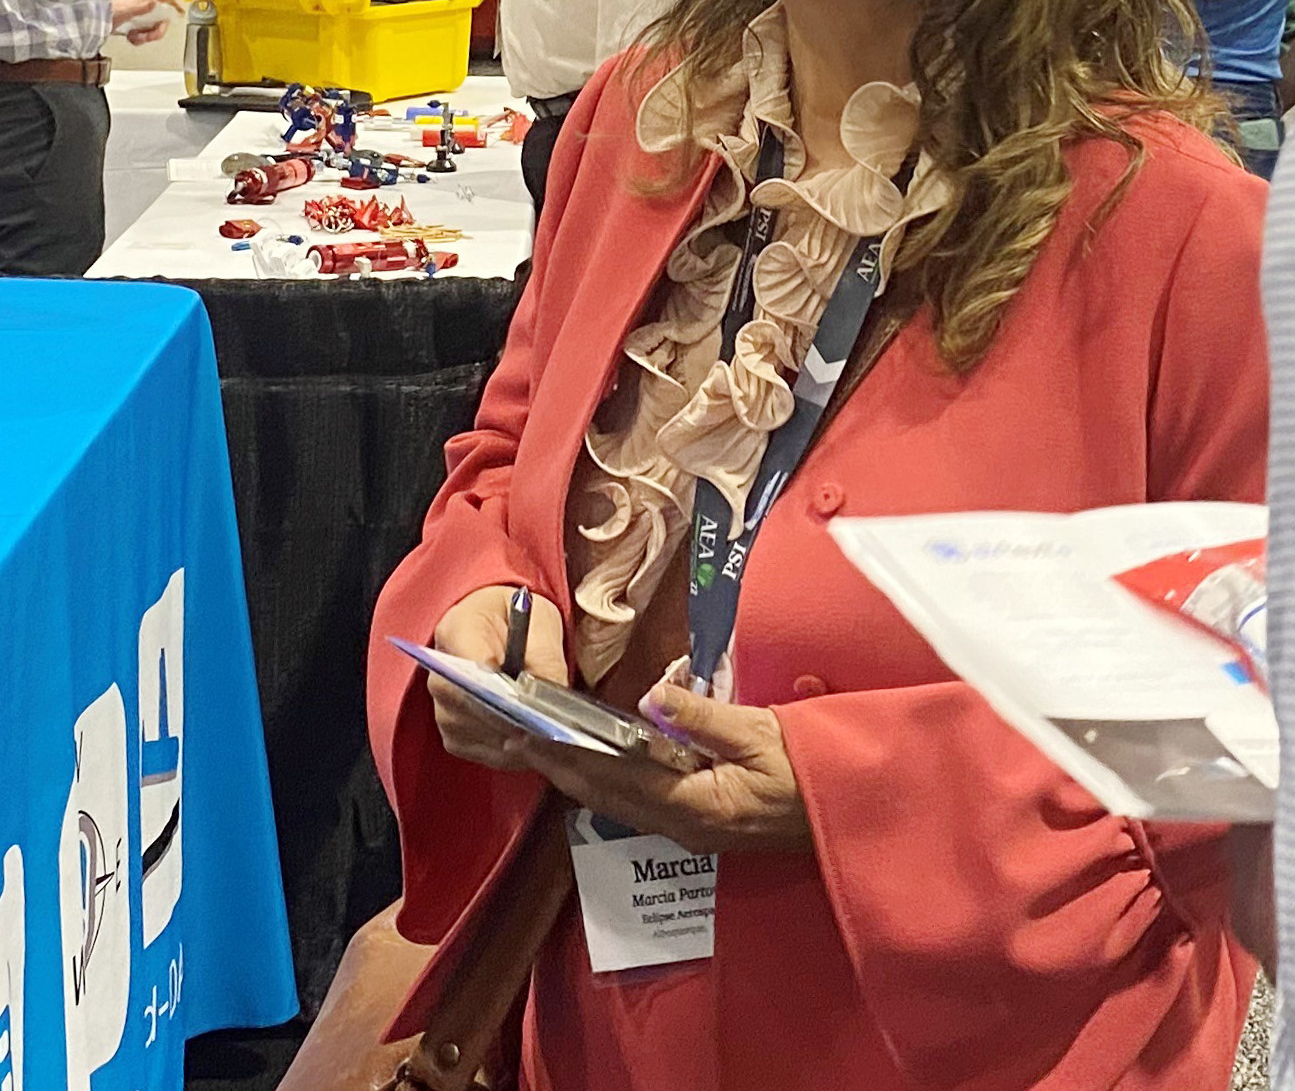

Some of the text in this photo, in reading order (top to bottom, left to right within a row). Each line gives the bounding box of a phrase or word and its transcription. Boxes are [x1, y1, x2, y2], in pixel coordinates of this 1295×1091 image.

[698, 515, 718, 559] AEA
[721, 541, 747, 580] PSI
[631, 855, 715, 883] Marcia
[632, 887, 715, 907] Marcia Parto
[642, 912, 676, 925] Eclipse
